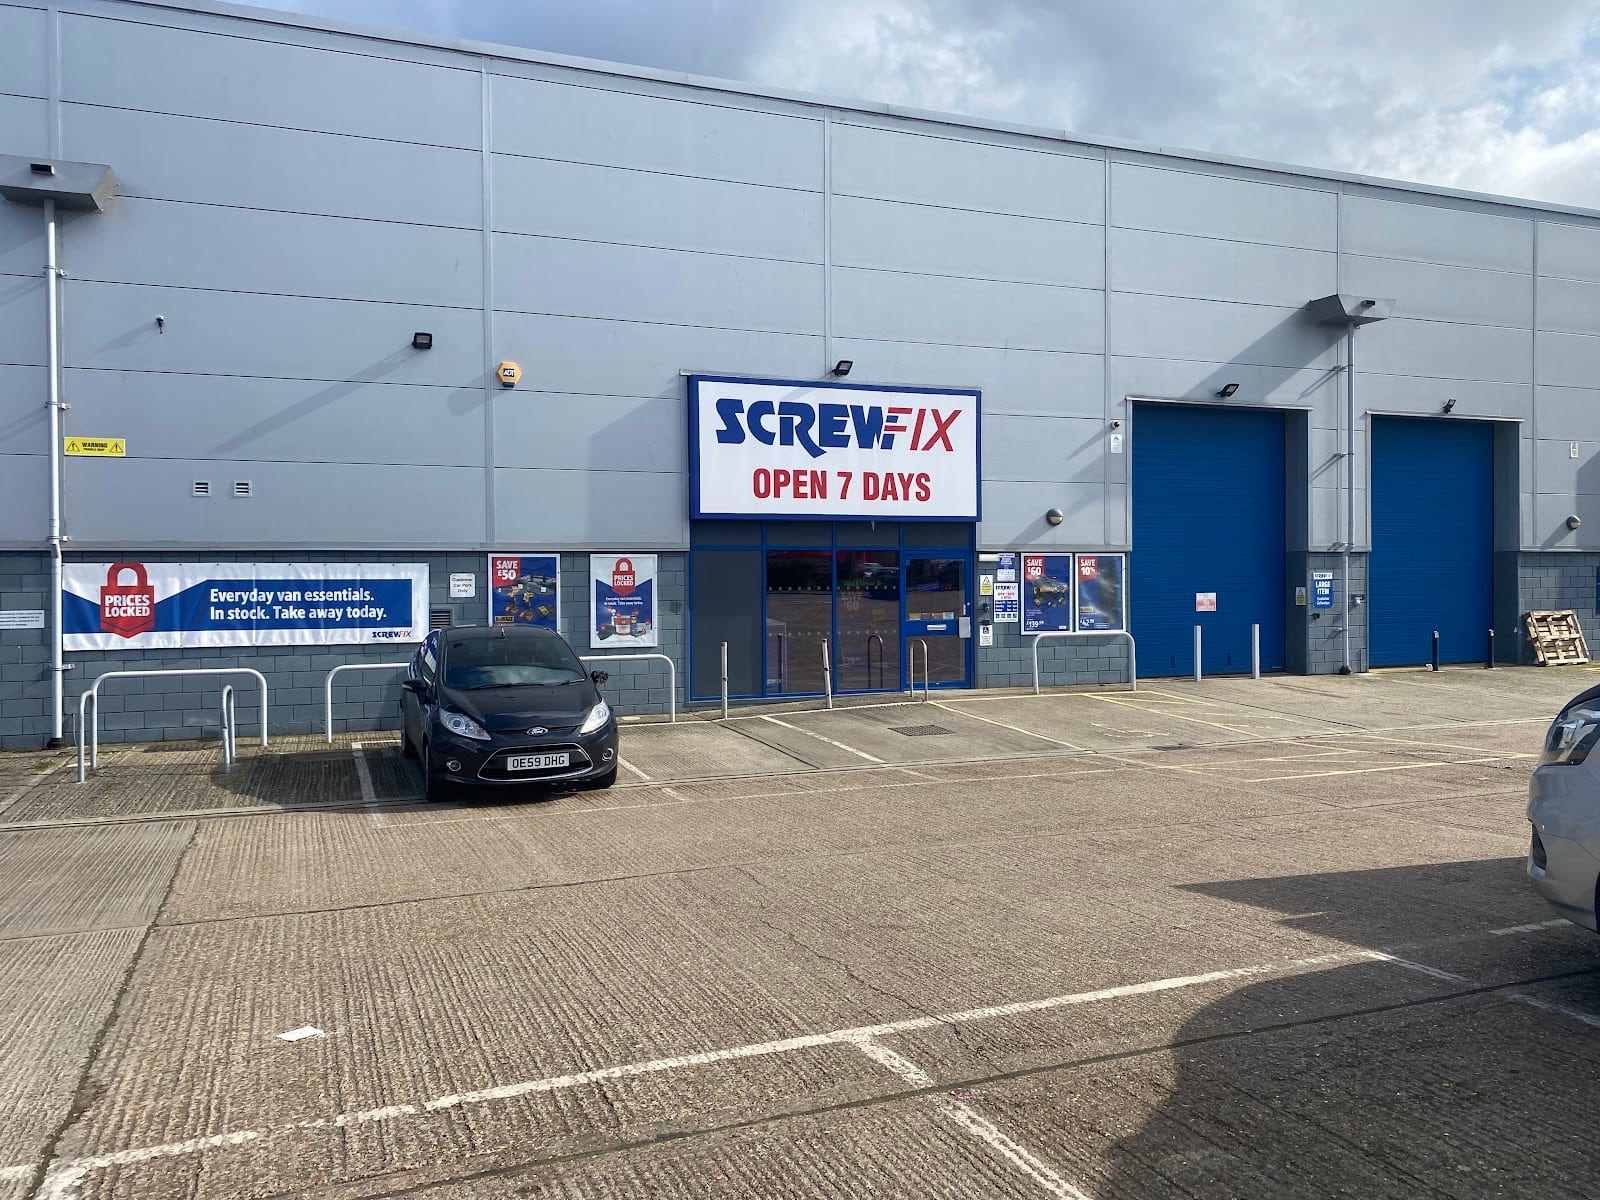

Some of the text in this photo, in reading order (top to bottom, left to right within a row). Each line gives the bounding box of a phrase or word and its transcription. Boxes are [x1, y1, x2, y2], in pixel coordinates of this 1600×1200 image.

[715, 398, 962, 458] SCREWFIX
[753, 468, 931, 502] OPEN 7 DAYS
[496, 560, 518, 569] SAVE
[498, 570, 516, 580] £50
[1028, 567, 1042, 576] £60
[1080, 567, 1096, 576] 10%
[104, 594, 150, 606] PRICES
[210, 588, 374, 605] Everyday van essentials.
[105, 606, 150, 618] LOCKED
[210, 605, 387, 622] In stock. Take away today.
[372, 630, 412, 638] SCREWFIX
[512, 756, 565, 768] OE59 DHG
